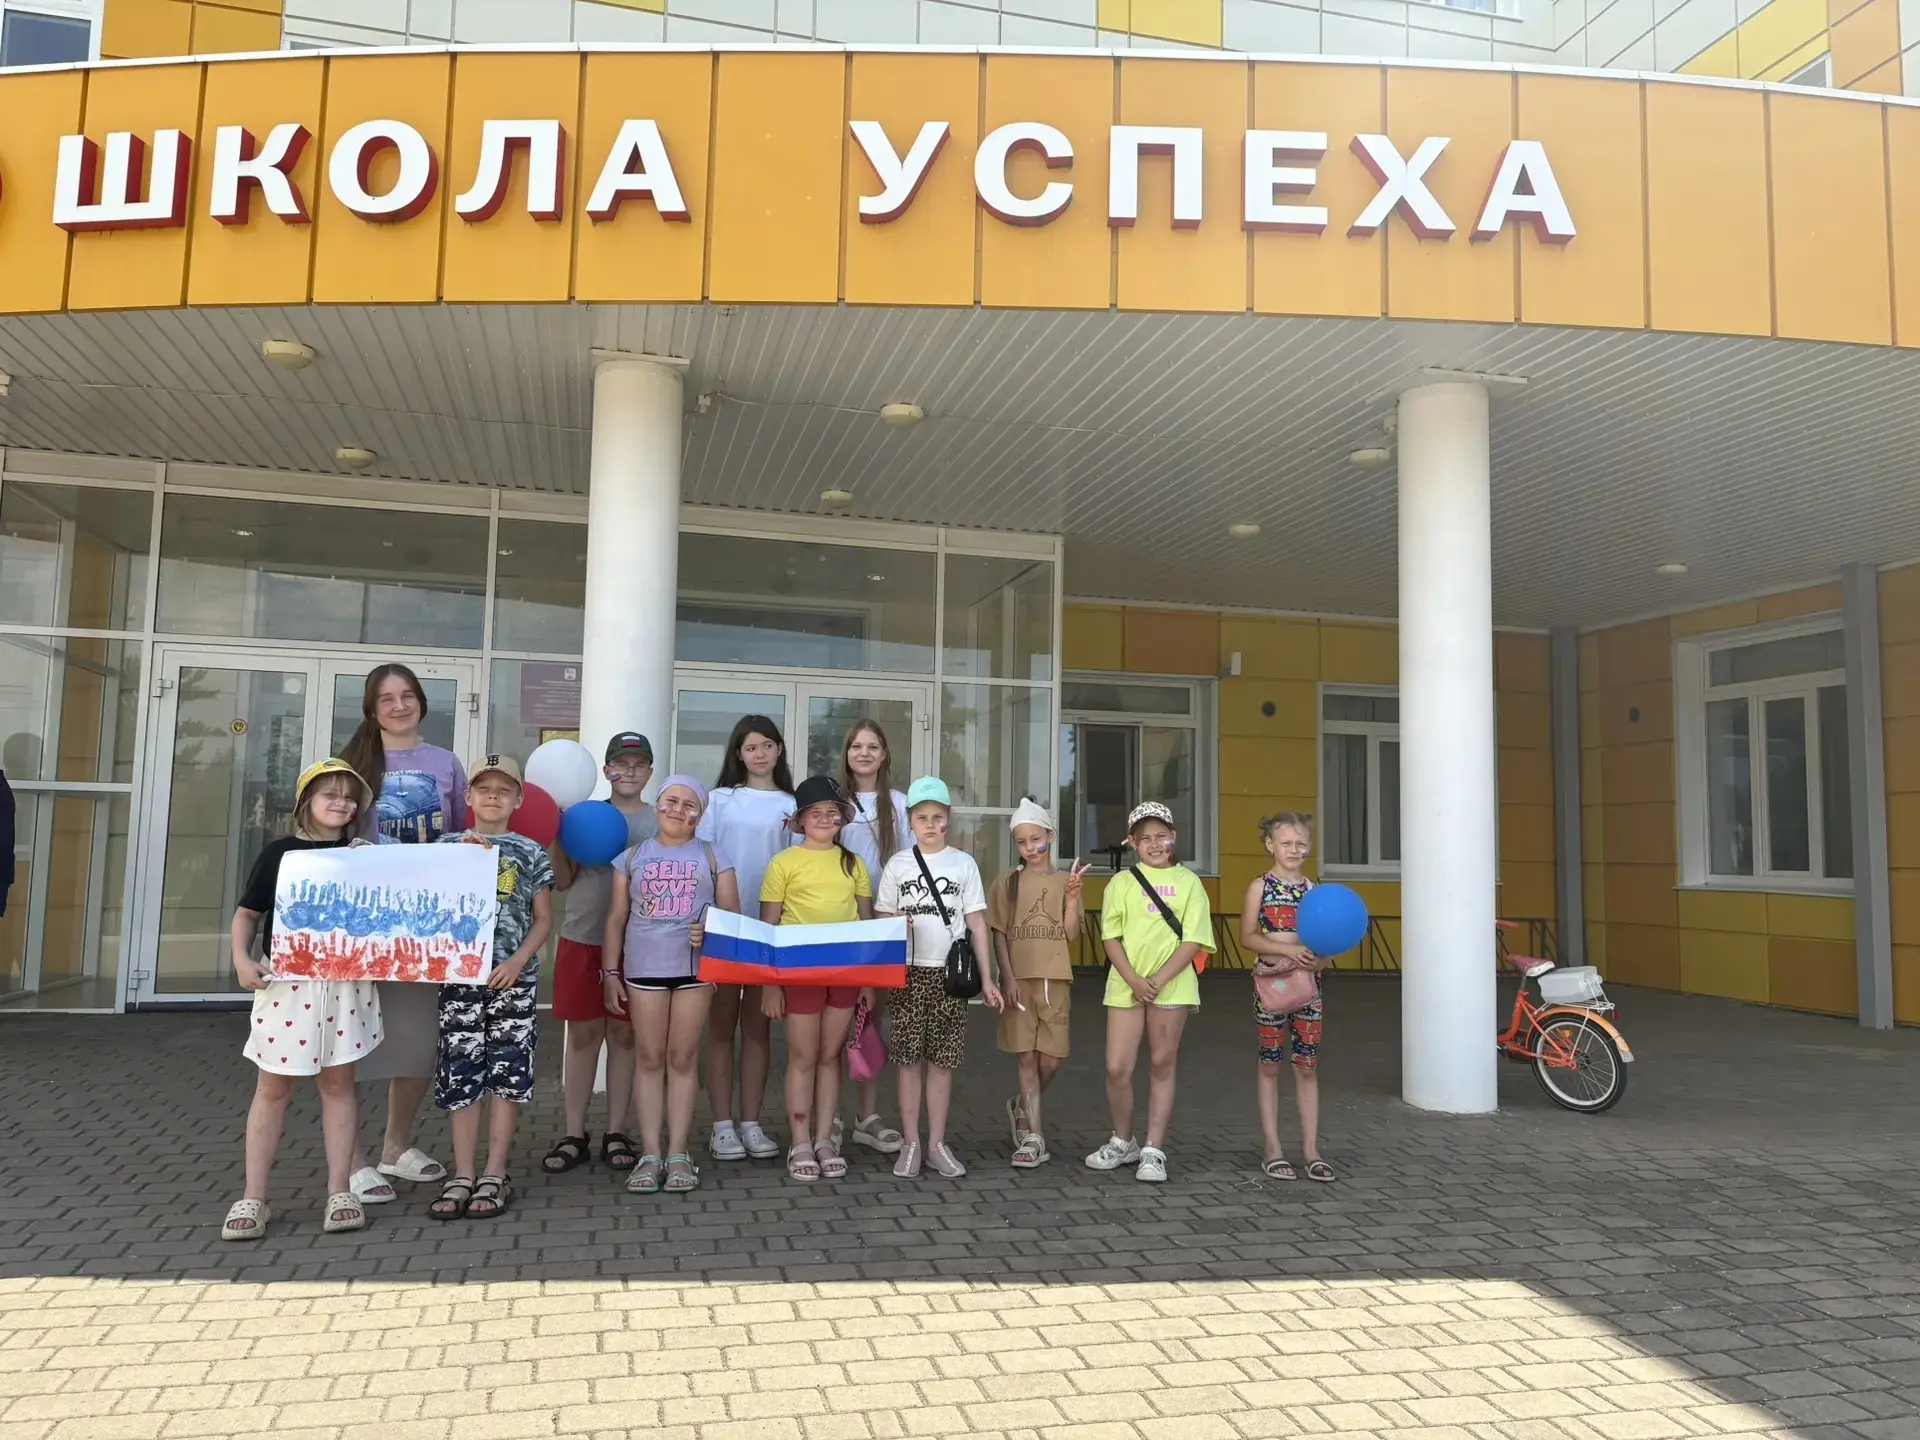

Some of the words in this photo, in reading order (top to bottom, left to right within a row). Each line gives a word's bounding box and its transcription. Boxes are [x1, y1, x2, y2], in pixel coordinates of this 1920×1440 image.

[53, 119, 690, 228] ШКОЛА
[849, 121, 1577, 242] УСПЕХА
[642, 860, 698, 880] SELF
[640, 879, 698, 900] LOVE
[1012, 924, 1067, 941] JORDAN
